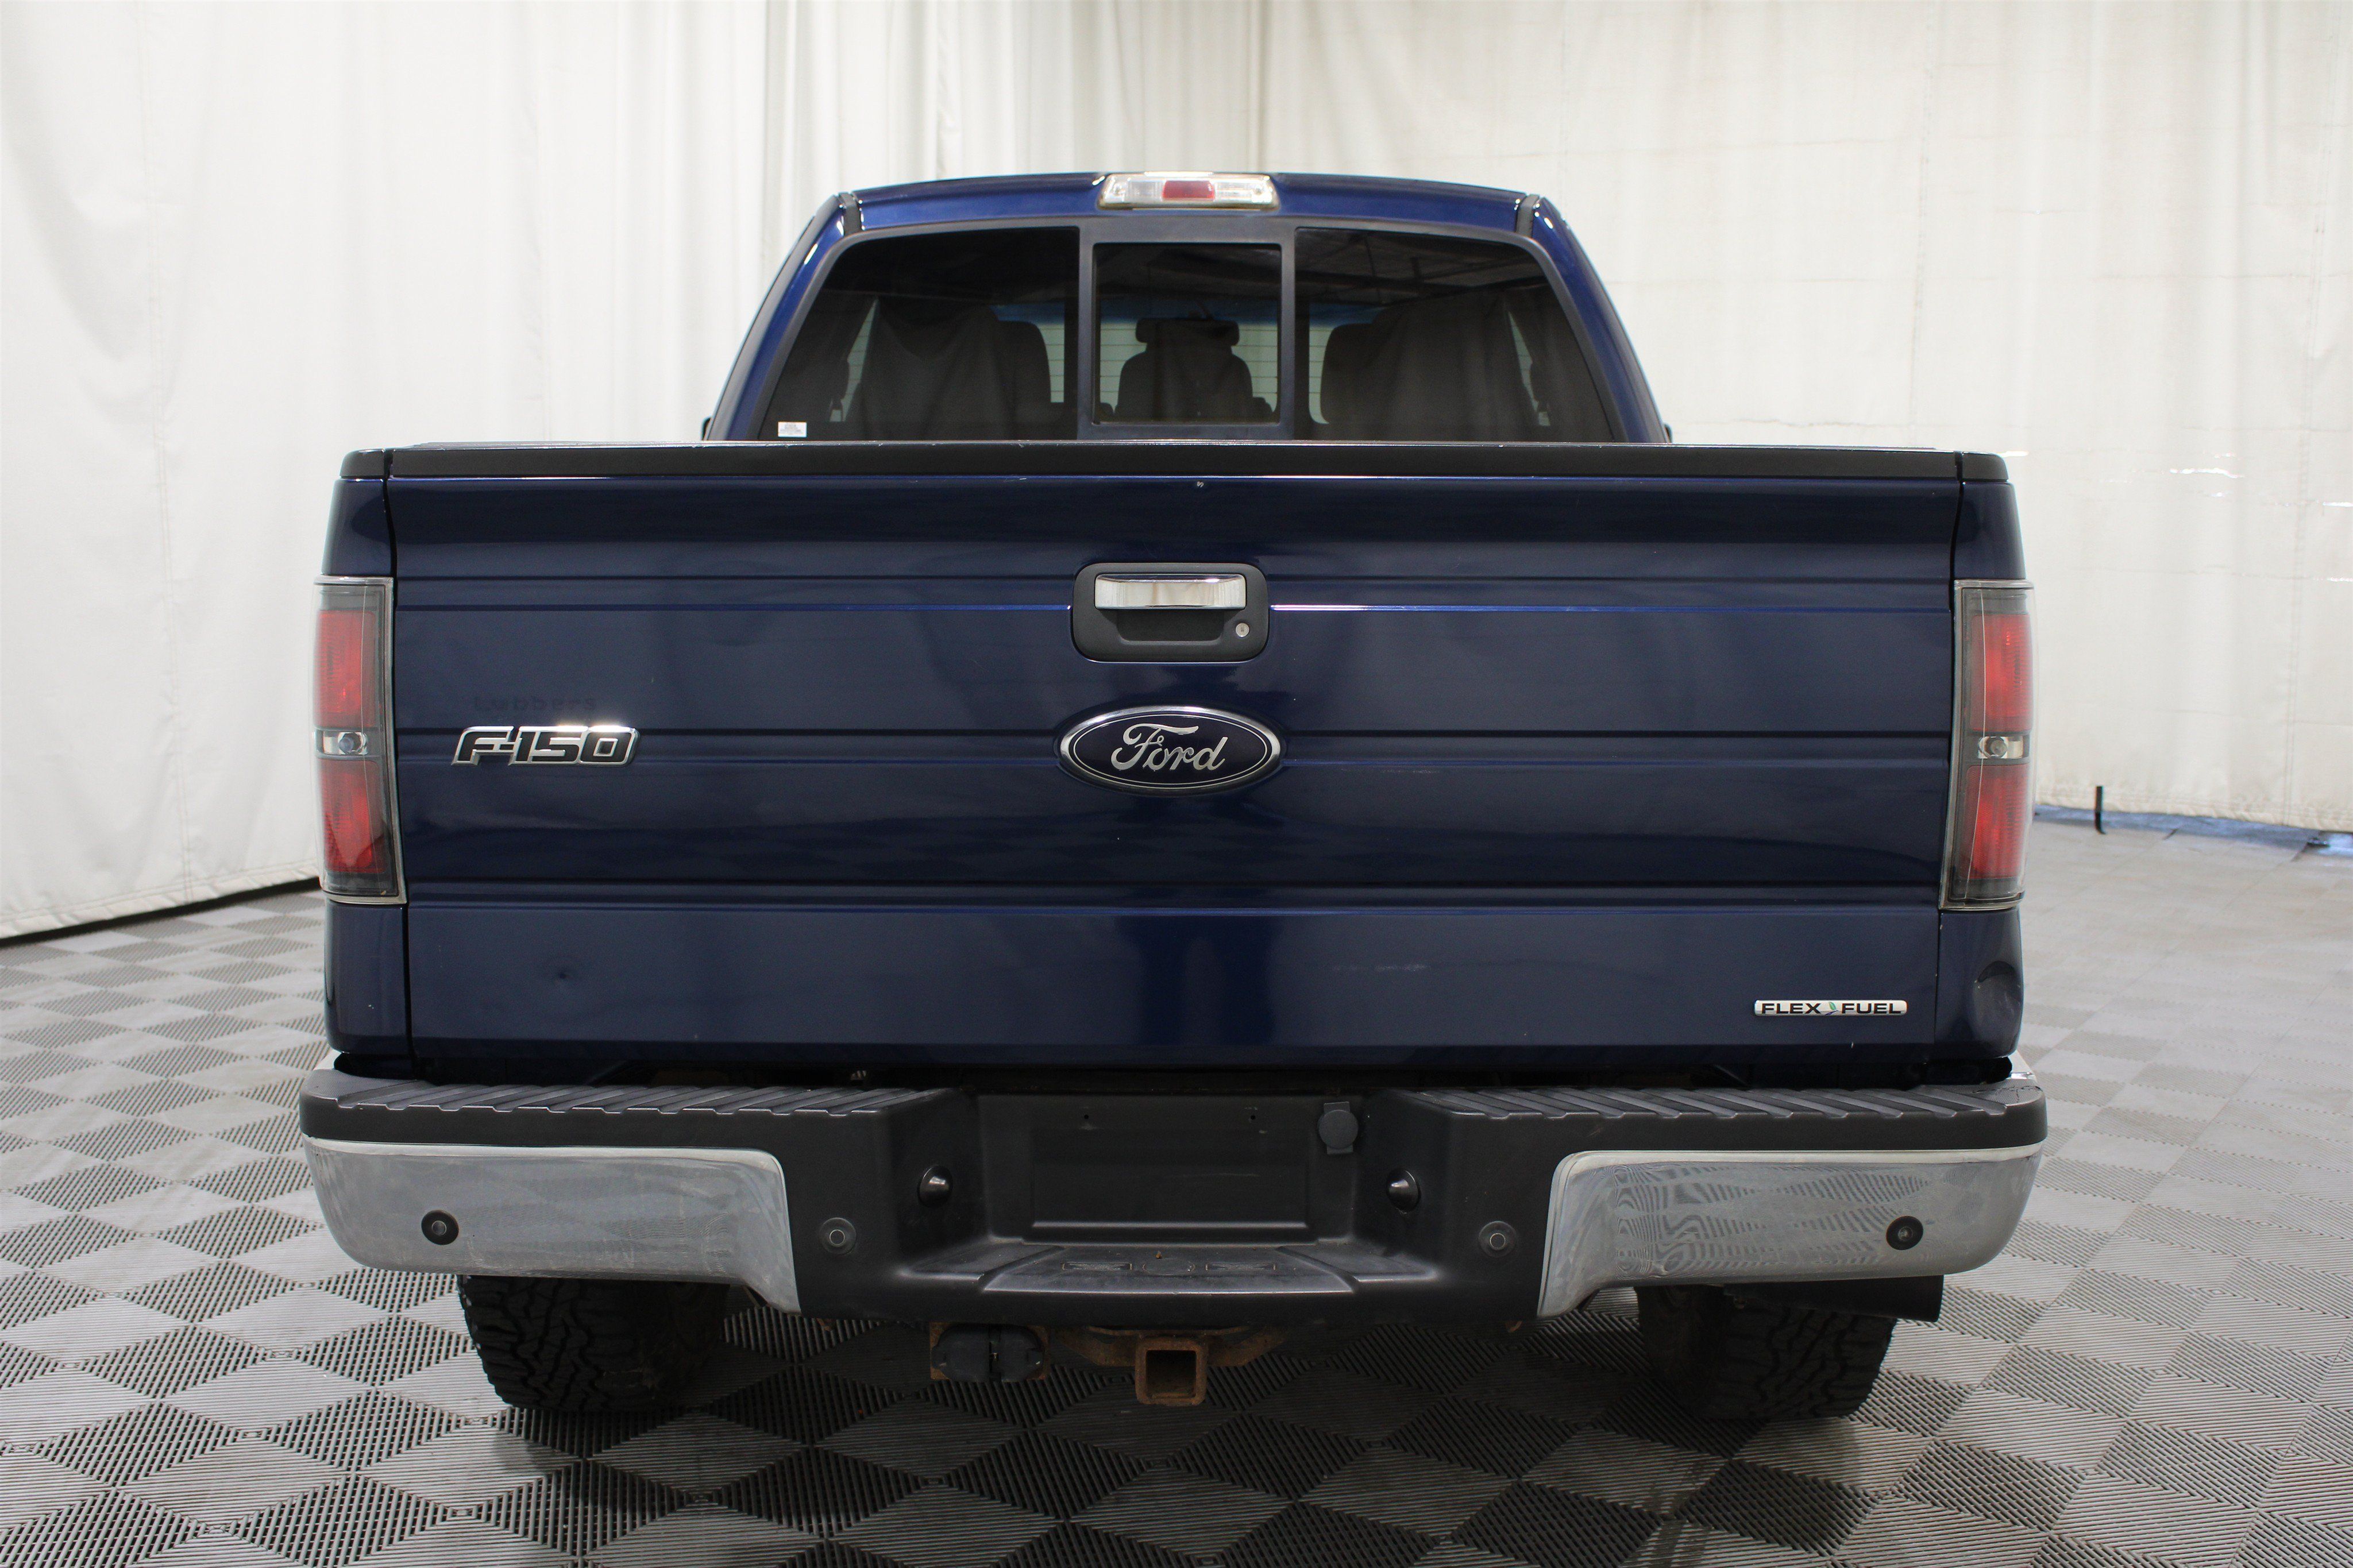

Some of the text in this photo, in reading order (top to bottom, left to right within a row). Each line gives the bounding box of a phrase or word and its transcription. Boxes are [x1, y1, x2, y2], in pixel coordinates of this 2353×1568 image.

[451, 725, 641, 767] F-150
[1110, 723, 1228, 771] Ford
[1761, 1003, 1901, 1014] FLEX FUEL
